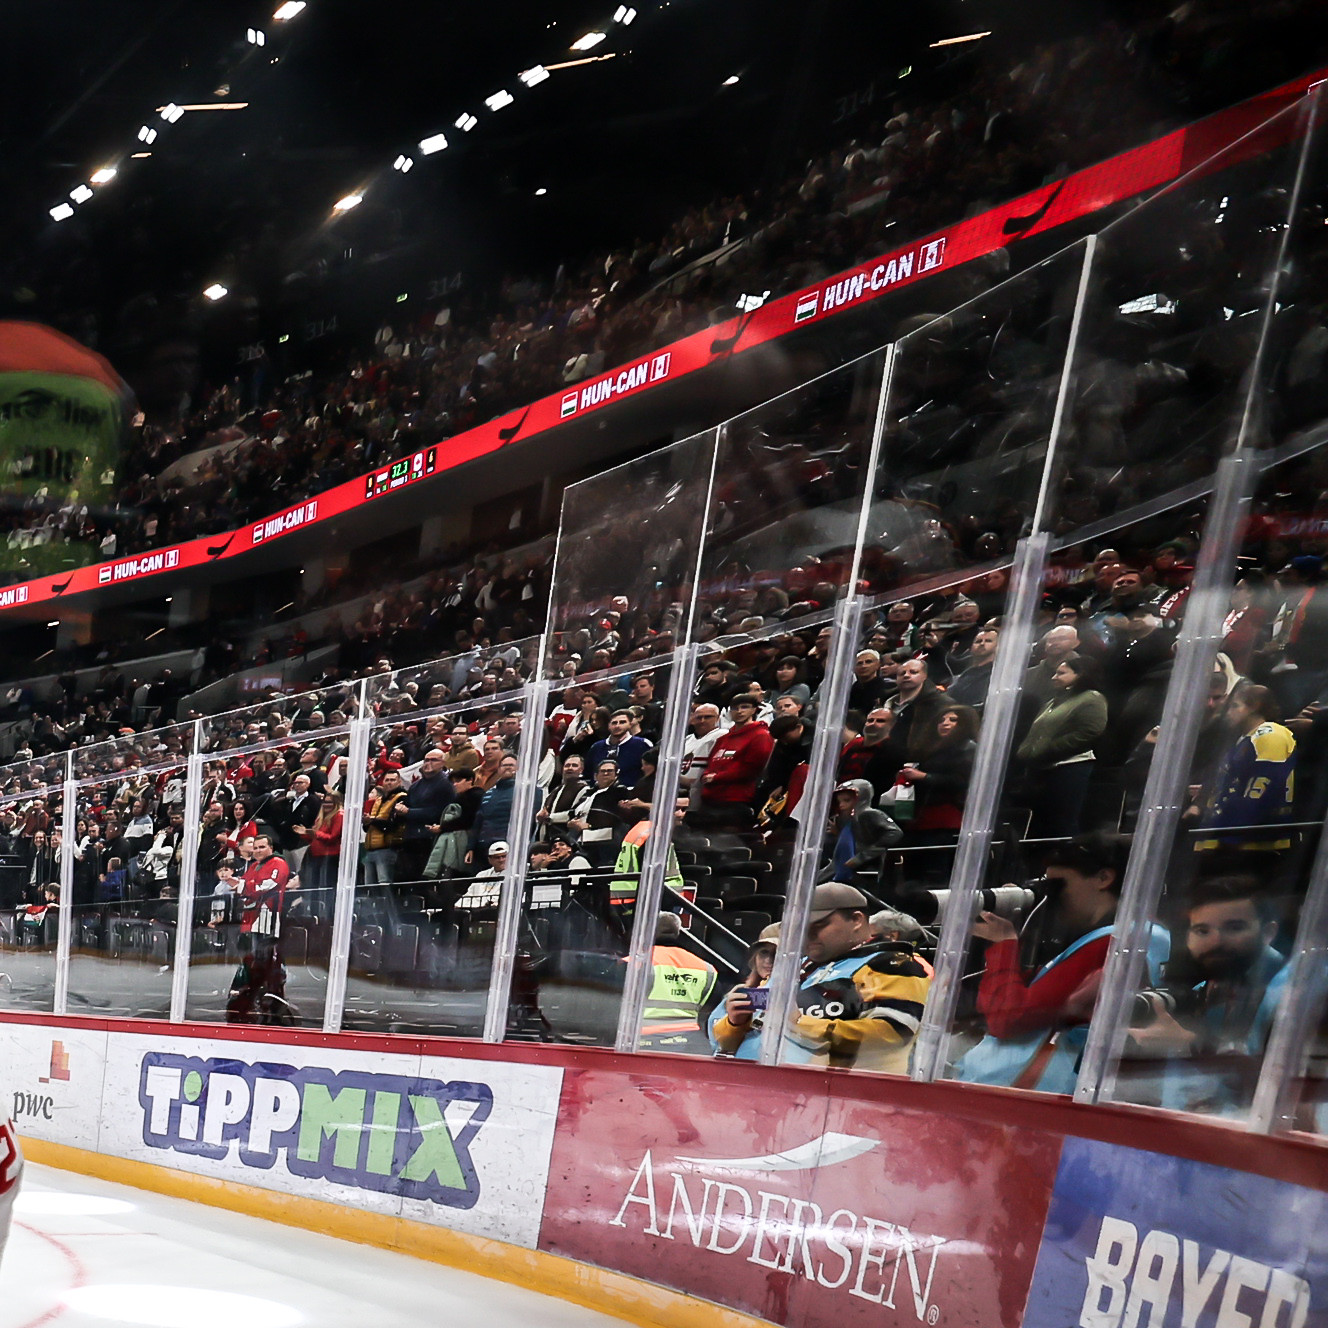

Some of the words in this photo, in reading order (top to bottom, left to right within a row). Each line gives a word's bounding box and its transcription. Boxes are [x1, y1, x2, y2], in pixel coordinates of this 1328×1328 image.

[823, 252, 914, 311] HUN-CAN
[580, 358, 648, 409] HUN-CAN
[265, 507, 304, 538] HUN-CAN
[114, 554, 163, 580] HUN-CAN
[14, 1090, 54, 1122] pwc
